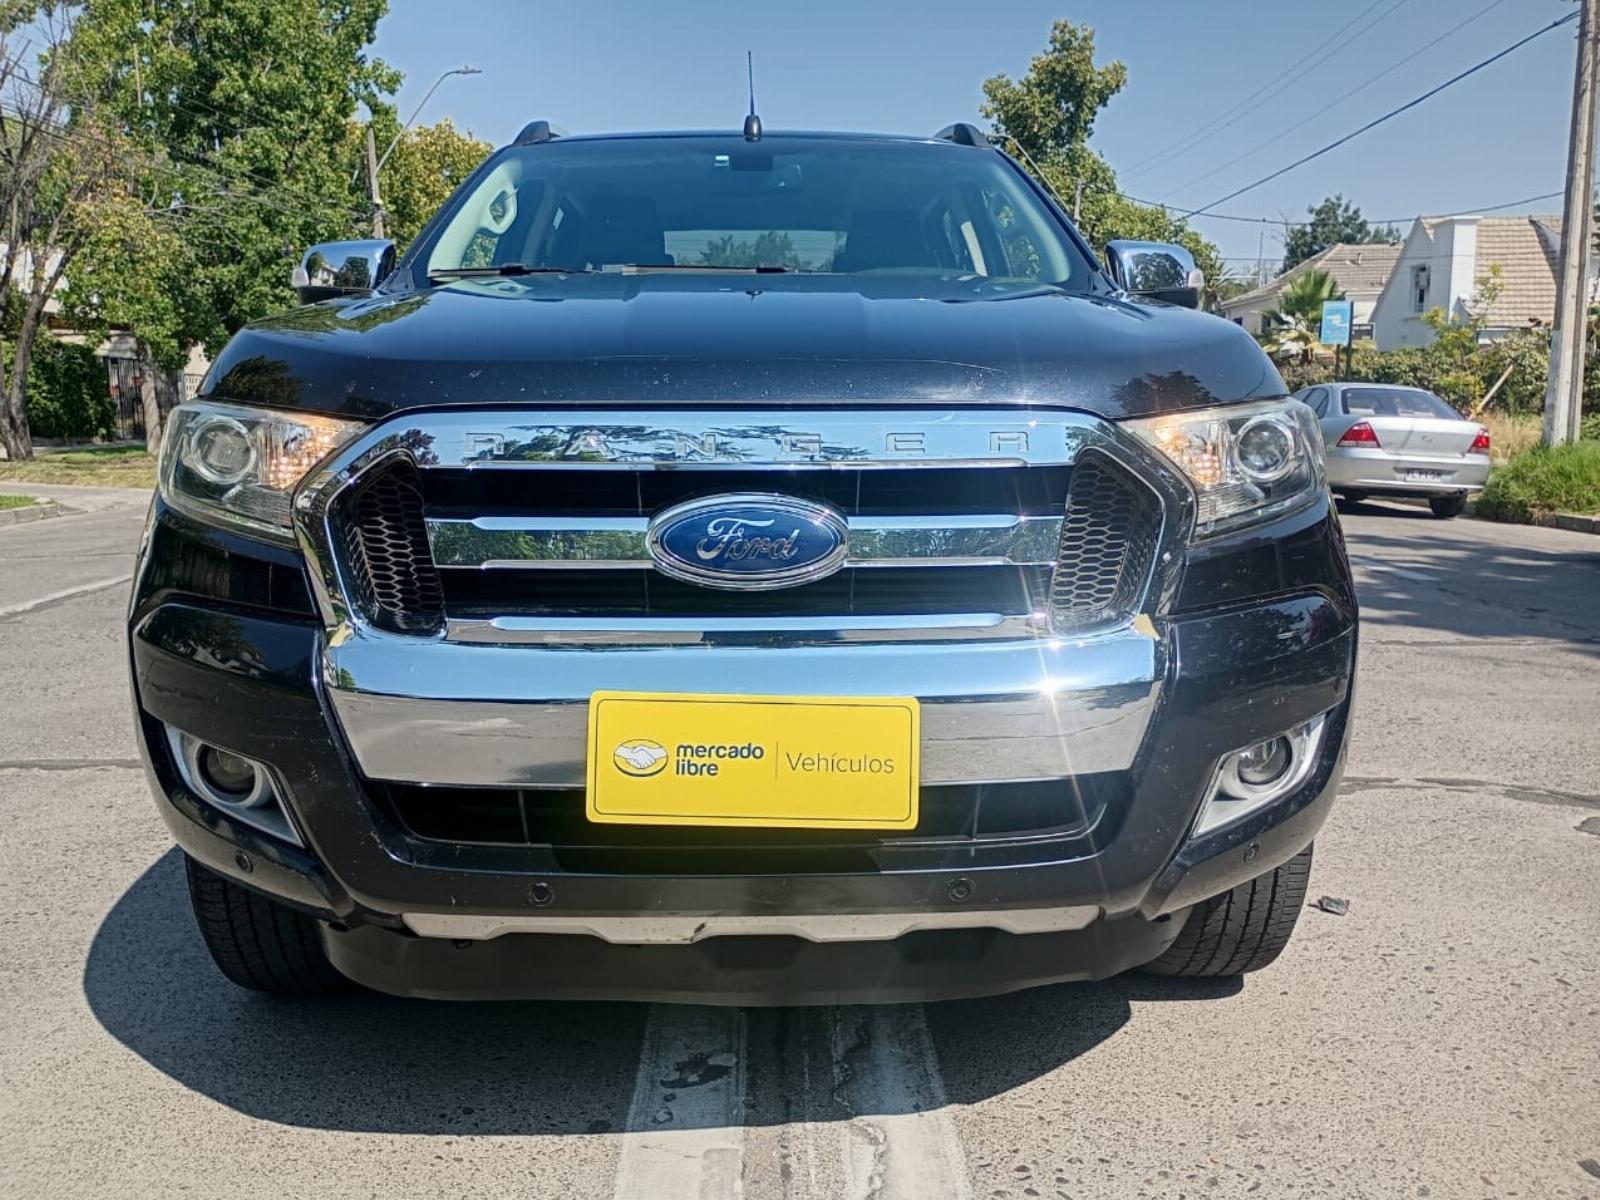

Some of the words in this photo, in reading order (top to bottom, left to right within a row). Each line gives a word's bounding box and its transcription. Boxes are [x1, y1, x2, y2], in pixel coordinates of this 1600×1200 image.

[463, 431, 1029, 457] RANGER
[697, 517, 800, 561] Ford
[676, 743, 764, 760] mercado
[786, 751, 895, 774] Vehículos
[675, 759, 719, 776] libre
